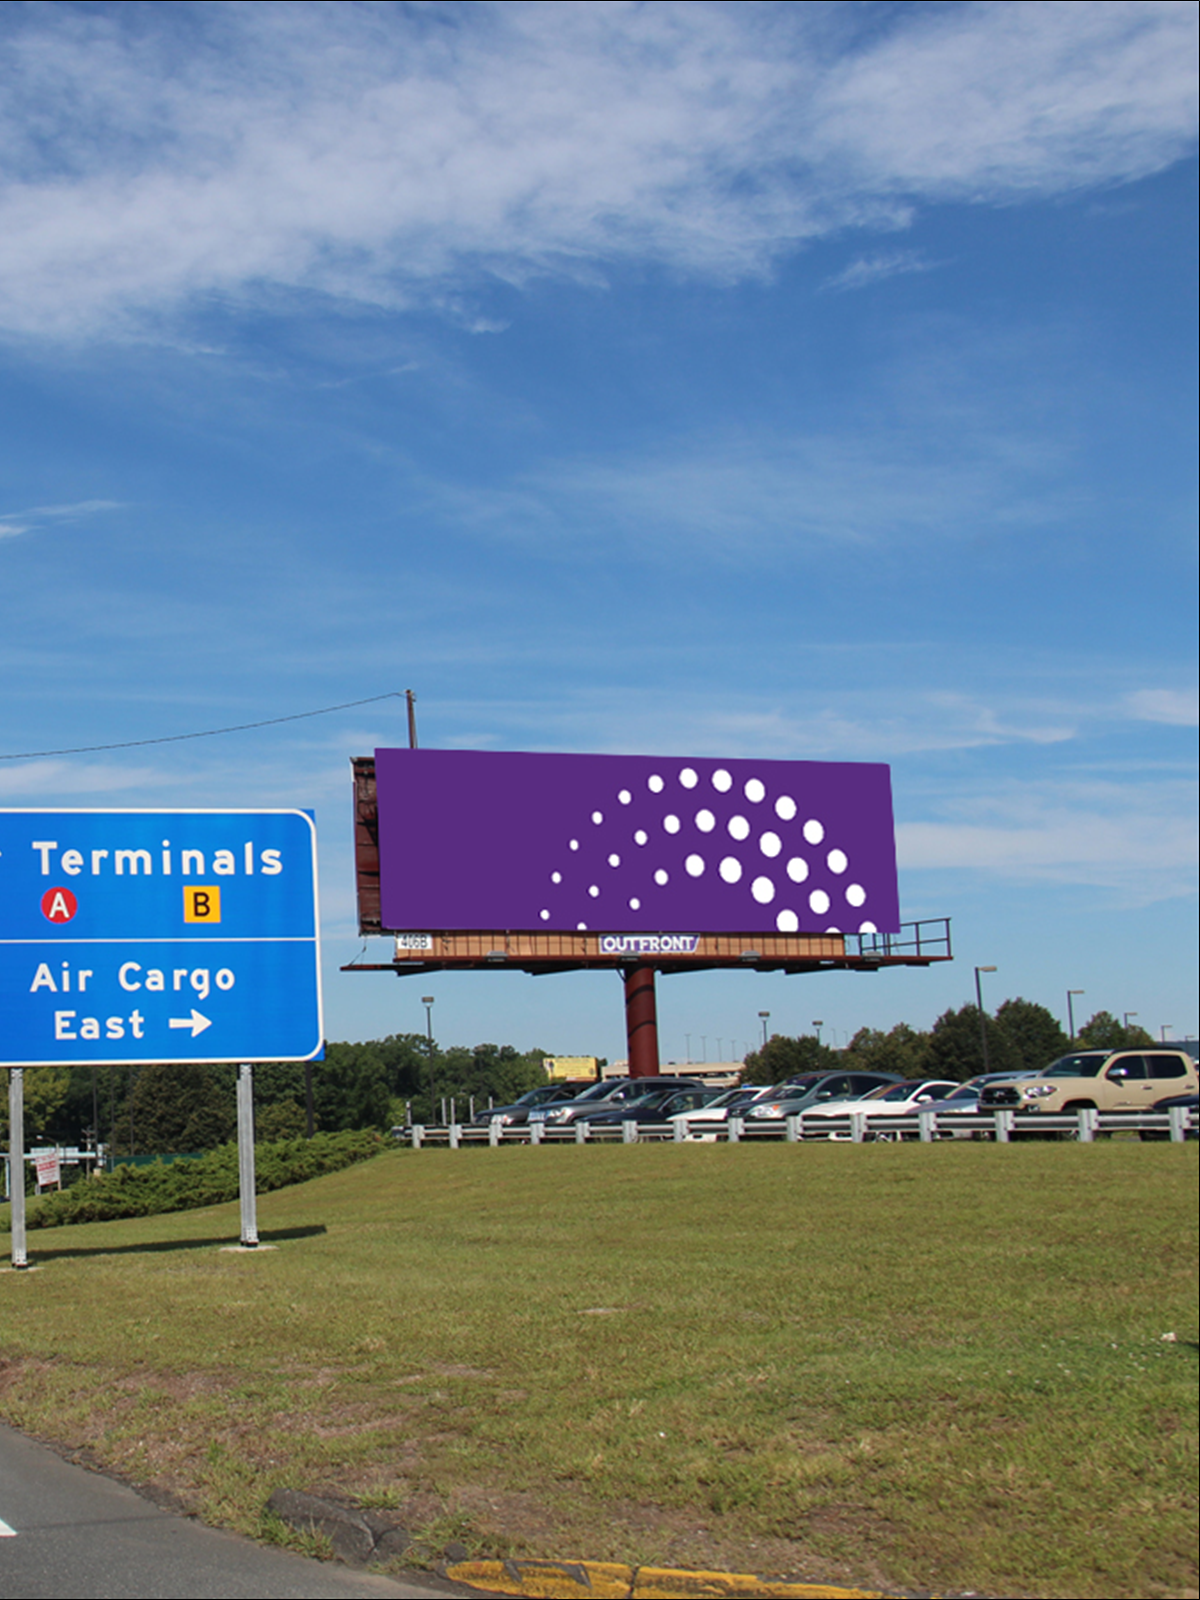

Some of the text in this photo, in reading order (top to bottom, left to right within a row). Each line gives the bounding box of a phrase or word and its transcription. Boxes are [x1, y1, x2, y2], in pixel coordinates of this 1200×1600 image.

[32, 840, 283, 876] Terminals
[49, 892, 210, 918] A B
[603, 935, 694, 951] OUTFRONT
[30, 961, 236, 1000] Air Cargo
[55, 1009, 145, 1040] East
